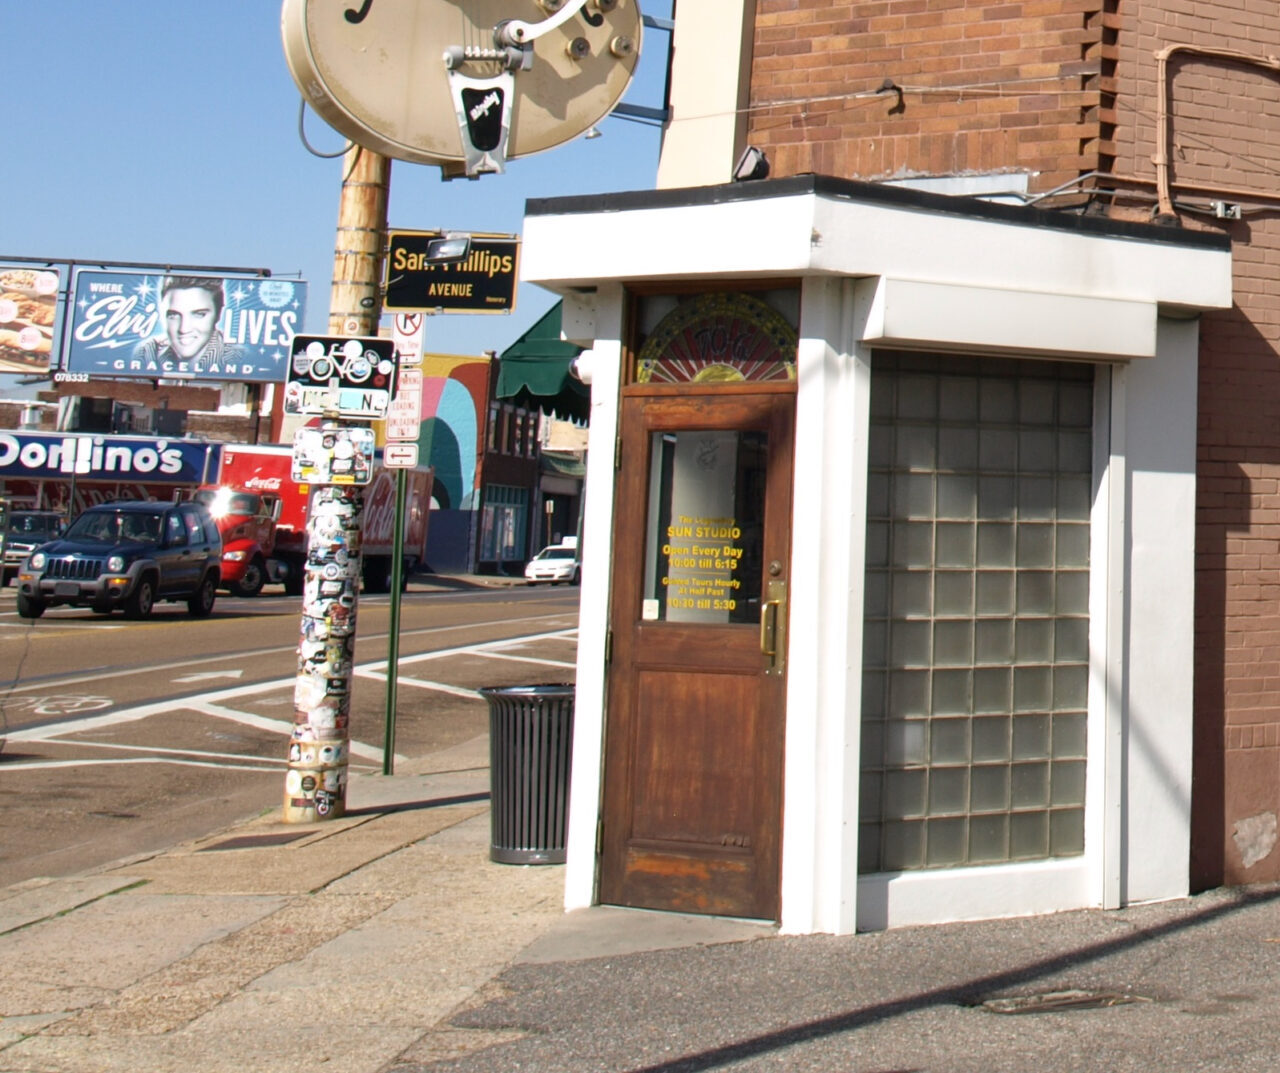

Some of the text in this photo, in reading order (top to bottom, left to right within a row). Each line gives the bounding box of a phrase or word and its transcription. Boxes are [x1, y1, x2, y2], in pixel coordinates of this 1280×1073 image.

[90, 282, 124, 294] WHERE
[429, 283, 473, 297] AVENUE
[75, 295, 297, 347] Elvis LIVES
[114, 360, 254, 374] GRACELAND
[668, 526, 741, 539] SUN STUDIO
[662, 544, 743, 559] Open Every Day
[668, 558, 738, 569] 10:00 till 6:15
[692, 578, 713, 586] Tours
[715, 579, 741, 589] Hourly
[707, 588, 724, 596] Past
[697, 599, 711, 609] till
[714, 599, 736, 610] 5:30
